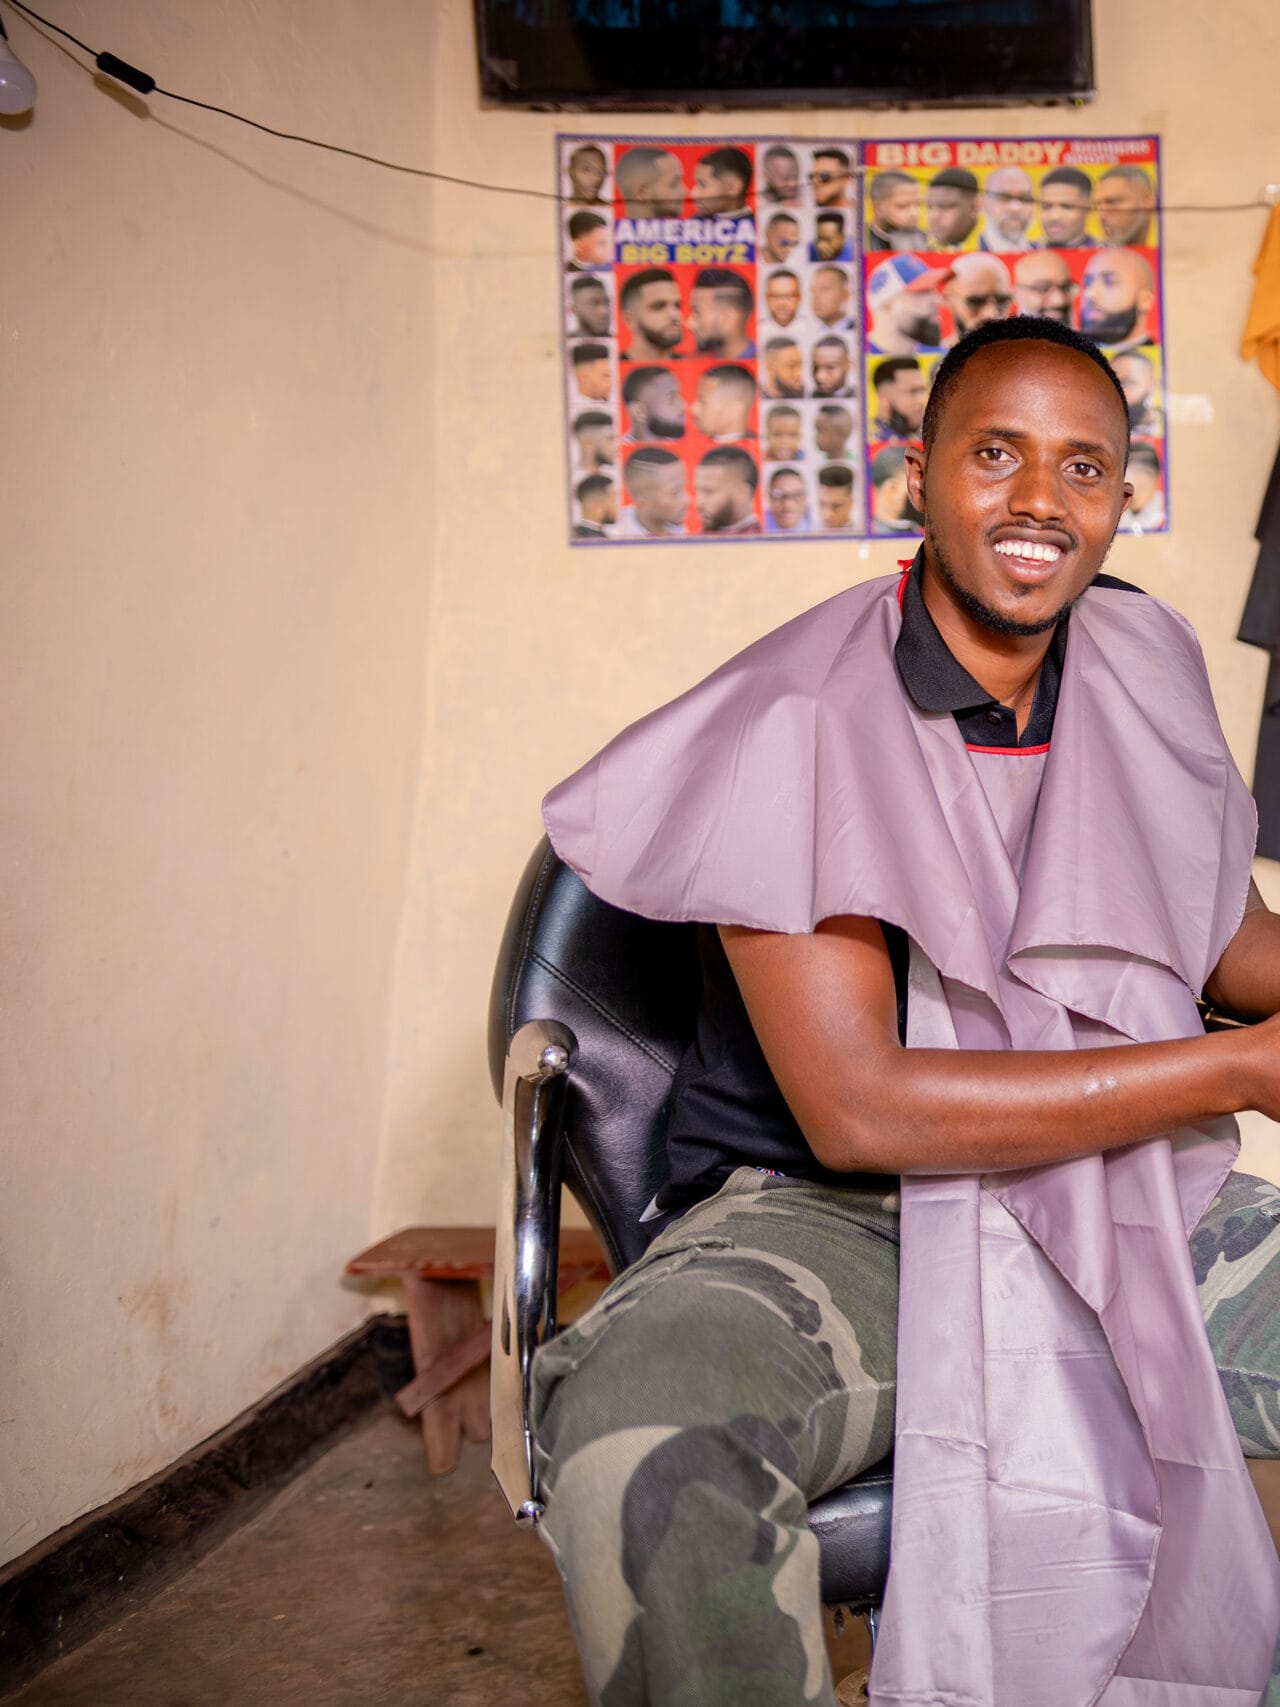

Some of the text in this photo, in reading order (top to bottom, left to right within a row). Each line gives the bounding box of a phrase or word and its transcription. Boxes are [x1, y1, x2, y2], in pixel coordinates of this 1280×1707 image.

[876, 142, 951, 165] BIG
[957, 141, 1066, 165] DADDY
[615, 218, 755, 243] AMERICA
[621, 243, 750, 264] BIG BOYZ
